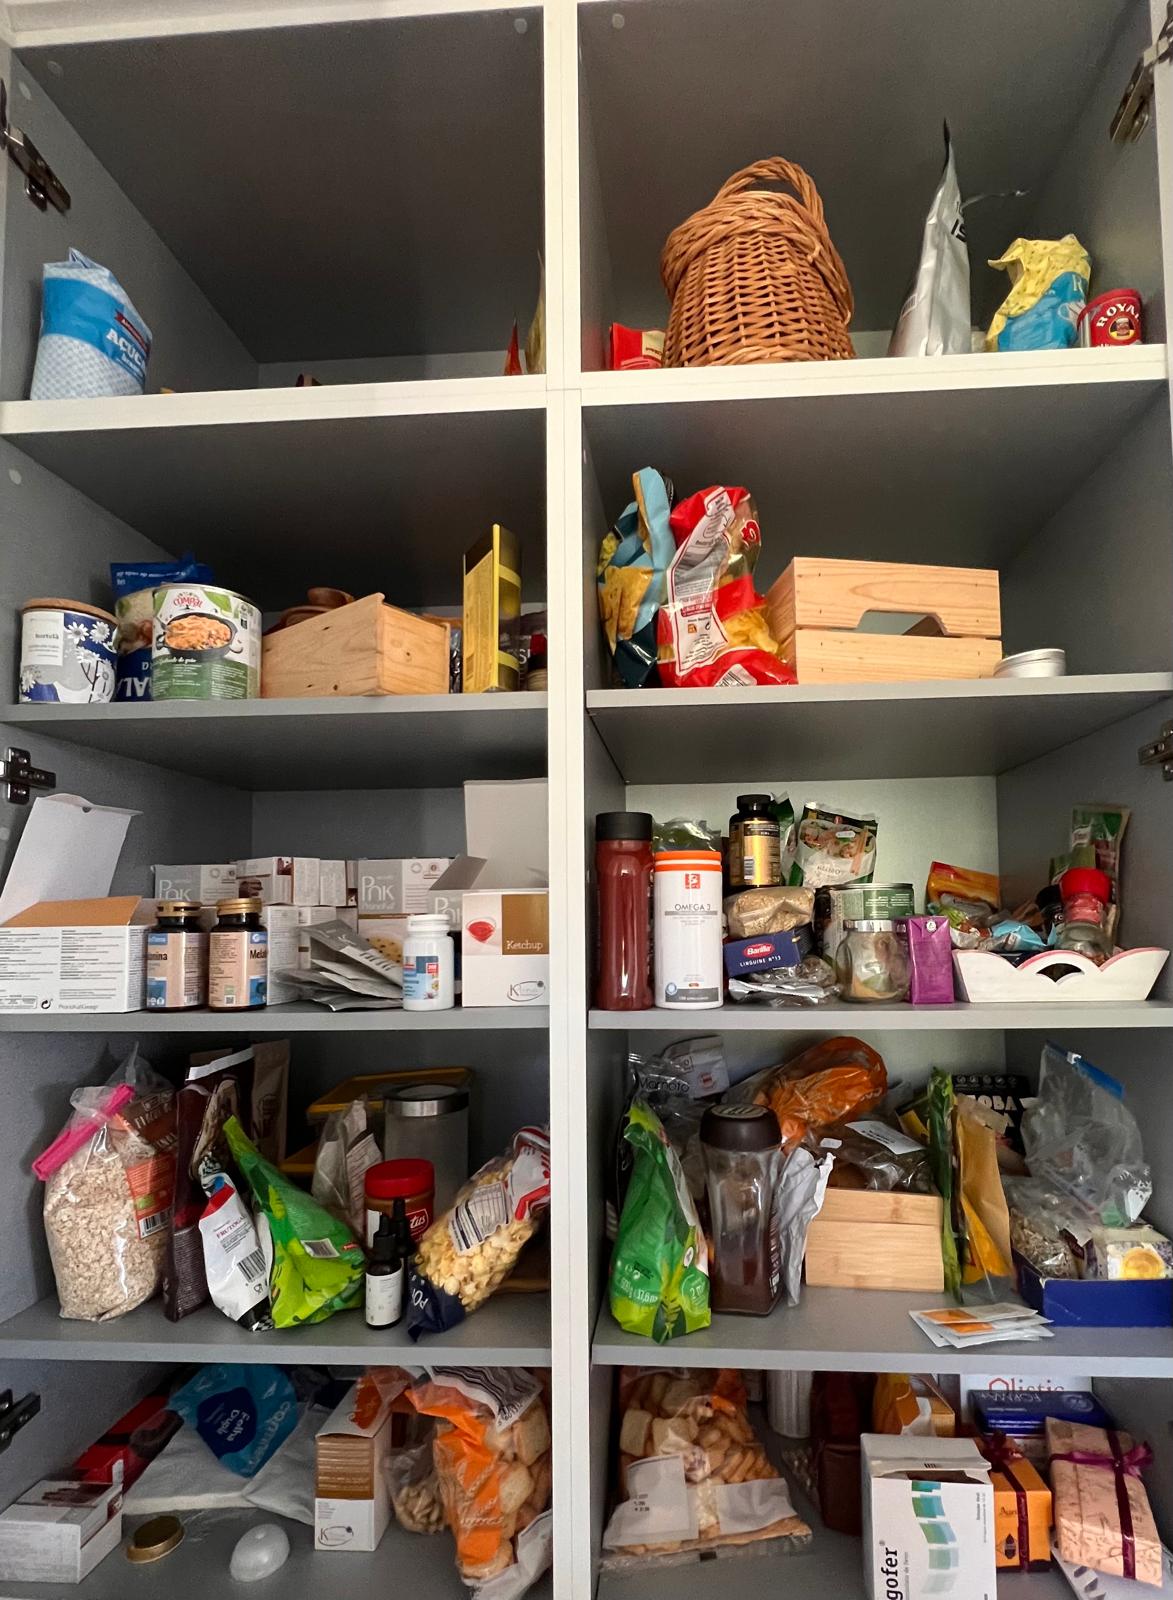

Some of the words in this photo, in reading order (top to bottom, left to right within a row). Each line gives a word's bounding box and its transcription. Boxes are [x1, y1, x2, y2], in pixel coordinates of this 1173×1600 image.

[674, 903, 705, 911] OMEGA
[506, 939, 544, 952] Ketchup
[746, 944, 772, 956] Barilla
[739, 957, 766, 967] LINGUINE
